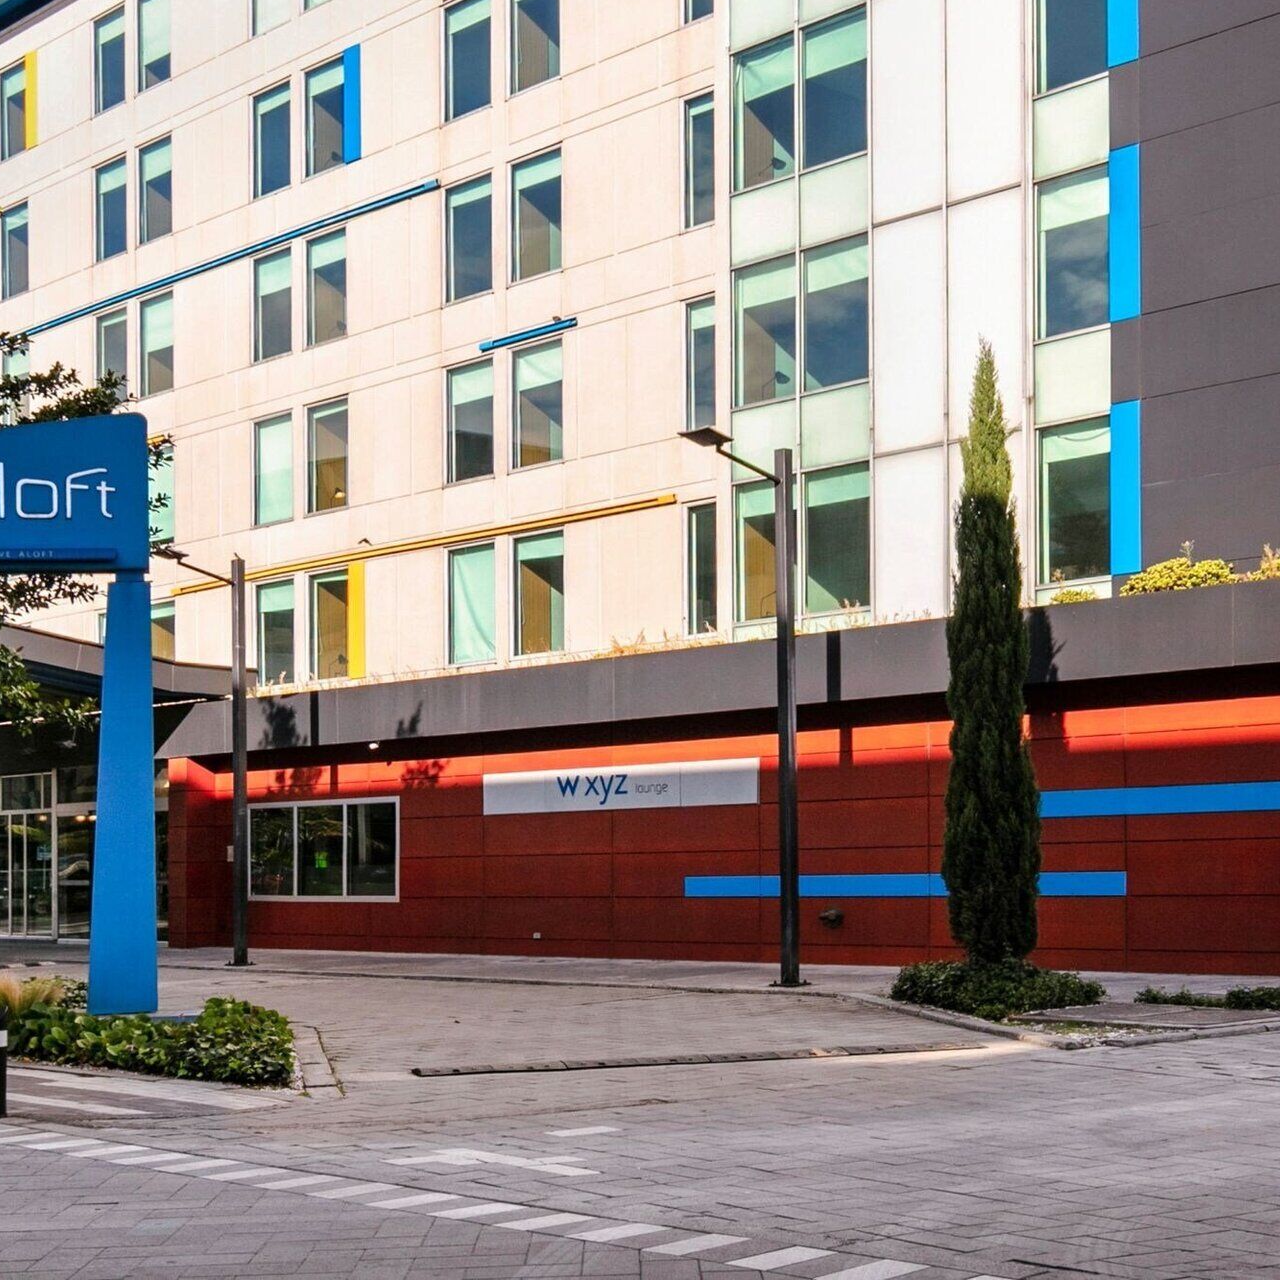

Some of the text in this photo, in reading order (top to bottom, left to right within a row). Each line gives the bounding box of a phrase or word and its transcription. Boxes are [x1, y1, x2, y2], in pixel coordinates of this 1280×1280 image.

[18, 550, 54, 559] ALOFT
[584, 773, 629, 806] xyz
[634, 782, 670, 795] lounge
